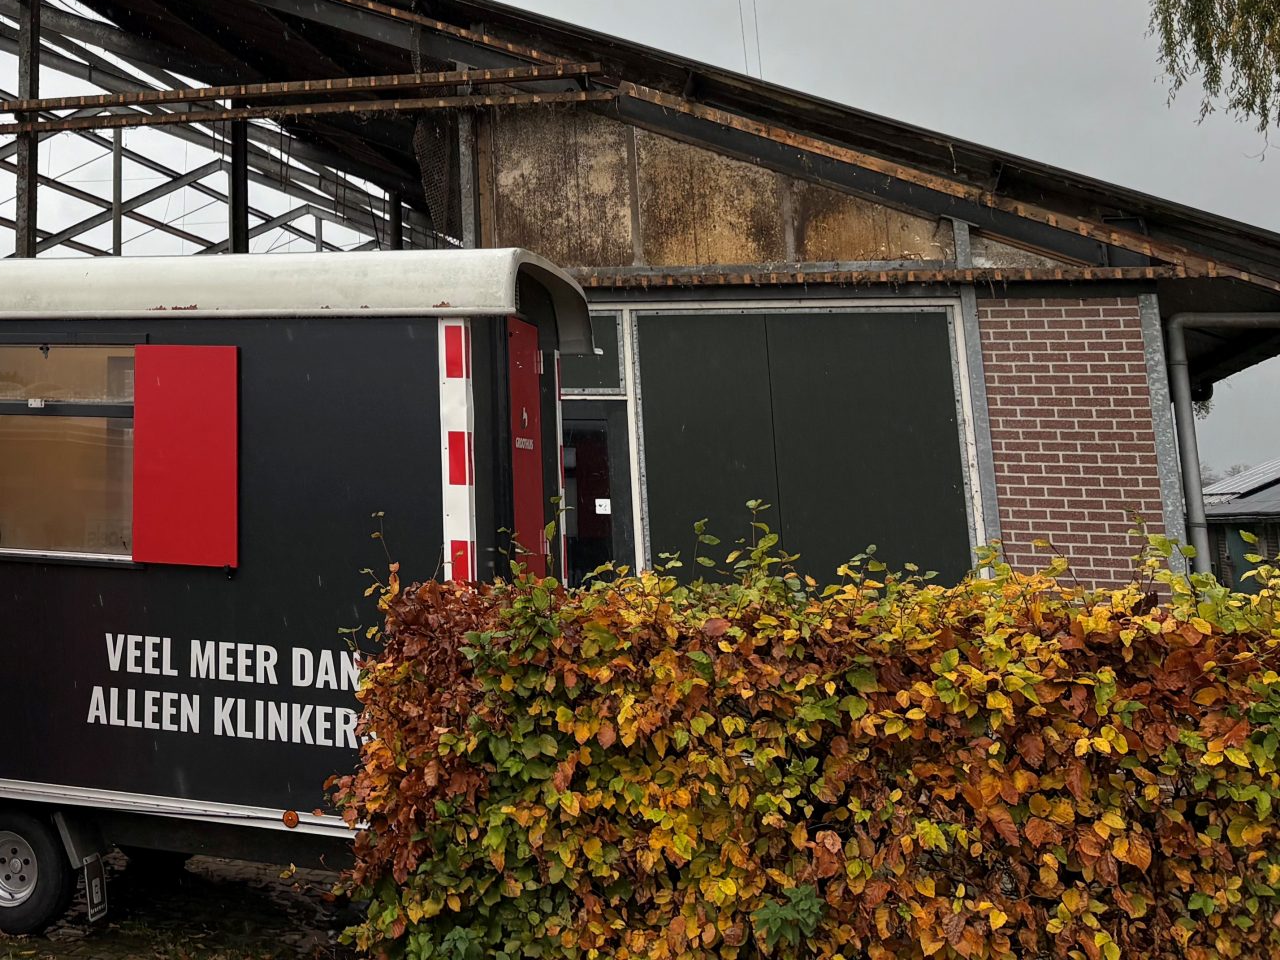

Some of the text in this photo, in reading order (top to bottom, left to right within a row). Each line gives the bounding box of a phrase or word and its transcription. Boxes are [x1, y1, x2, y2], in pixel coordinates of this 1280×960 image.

[105, 632, 362, 692] VEEL MEER DAN
[86, 685, 376, 749] ALLEEN KLINKER
